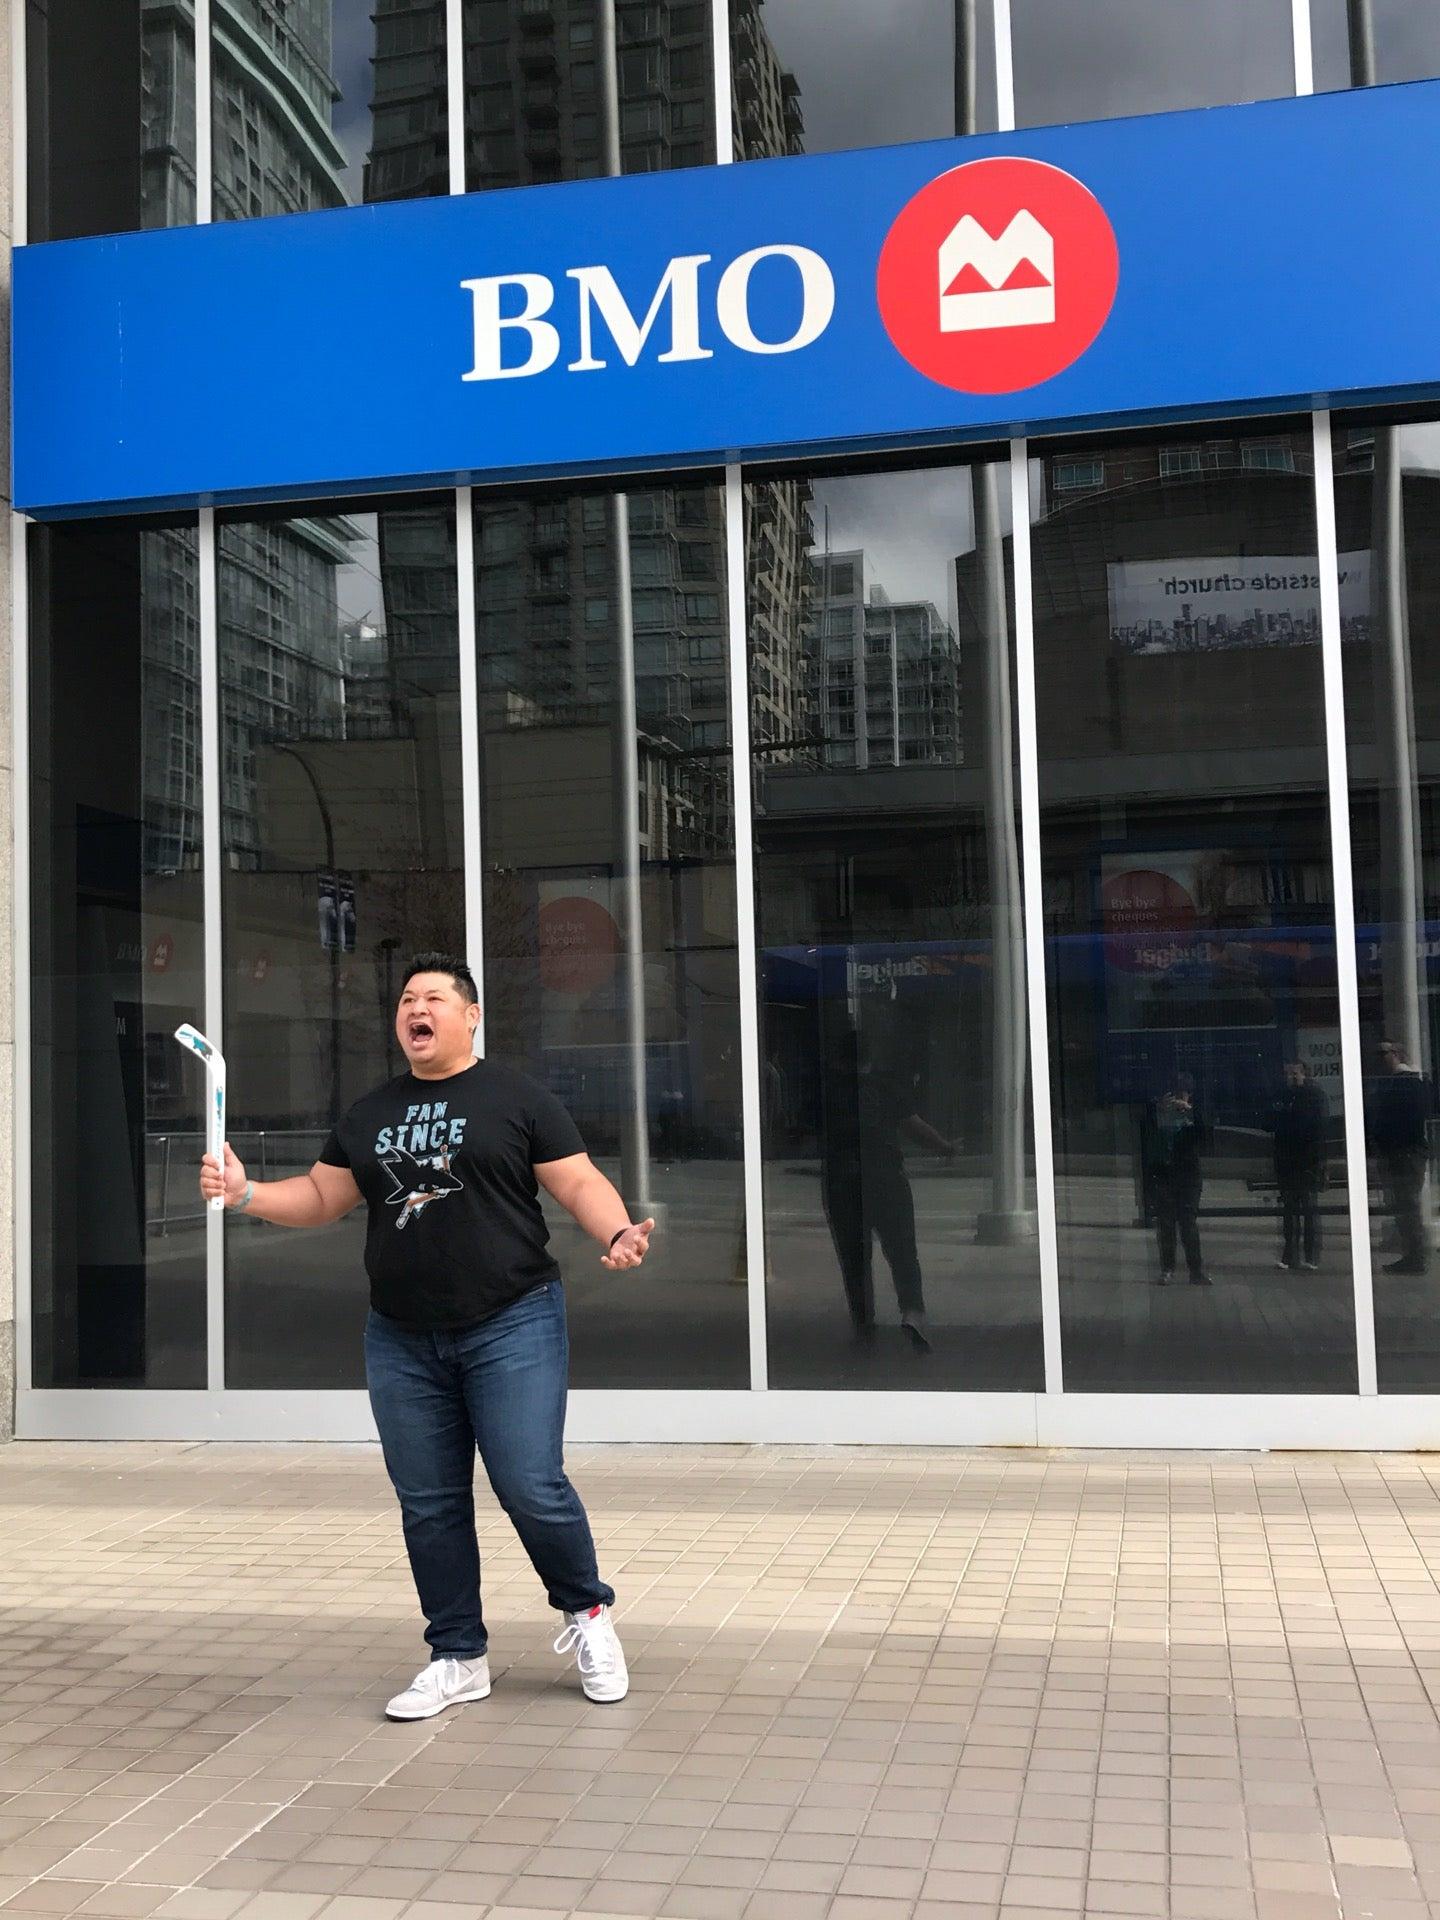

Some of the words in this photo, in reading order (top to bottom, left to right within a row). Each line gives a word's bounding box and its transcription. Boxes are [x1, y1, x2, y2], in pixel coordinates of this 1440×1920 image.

[460, 244, 835, 382] BMO
[405, 1101, 448, 1123] FAN
[375, 1118, 467, 1154] SINCE
